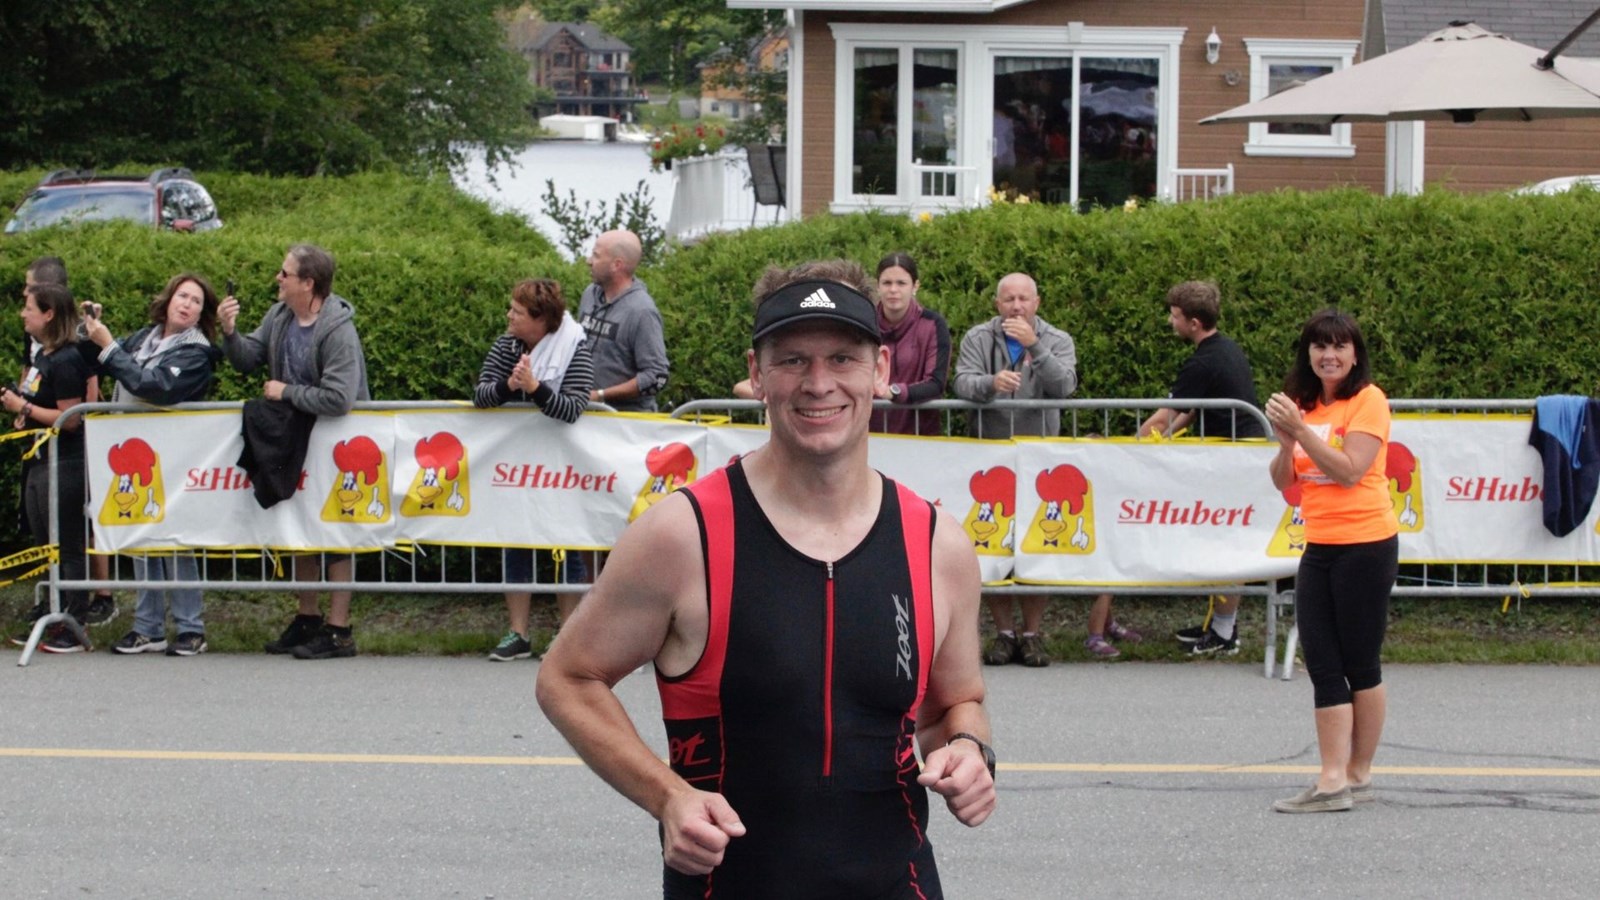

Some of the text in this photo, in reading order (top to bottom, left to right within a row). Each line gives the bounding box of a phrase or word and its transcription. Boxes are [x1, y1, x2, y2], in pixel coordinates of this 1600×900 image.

[800, 300, 836, 309] adidas
[184, 467, 308, 491] StHut
[1445, 476, 1545, 502] StHub
